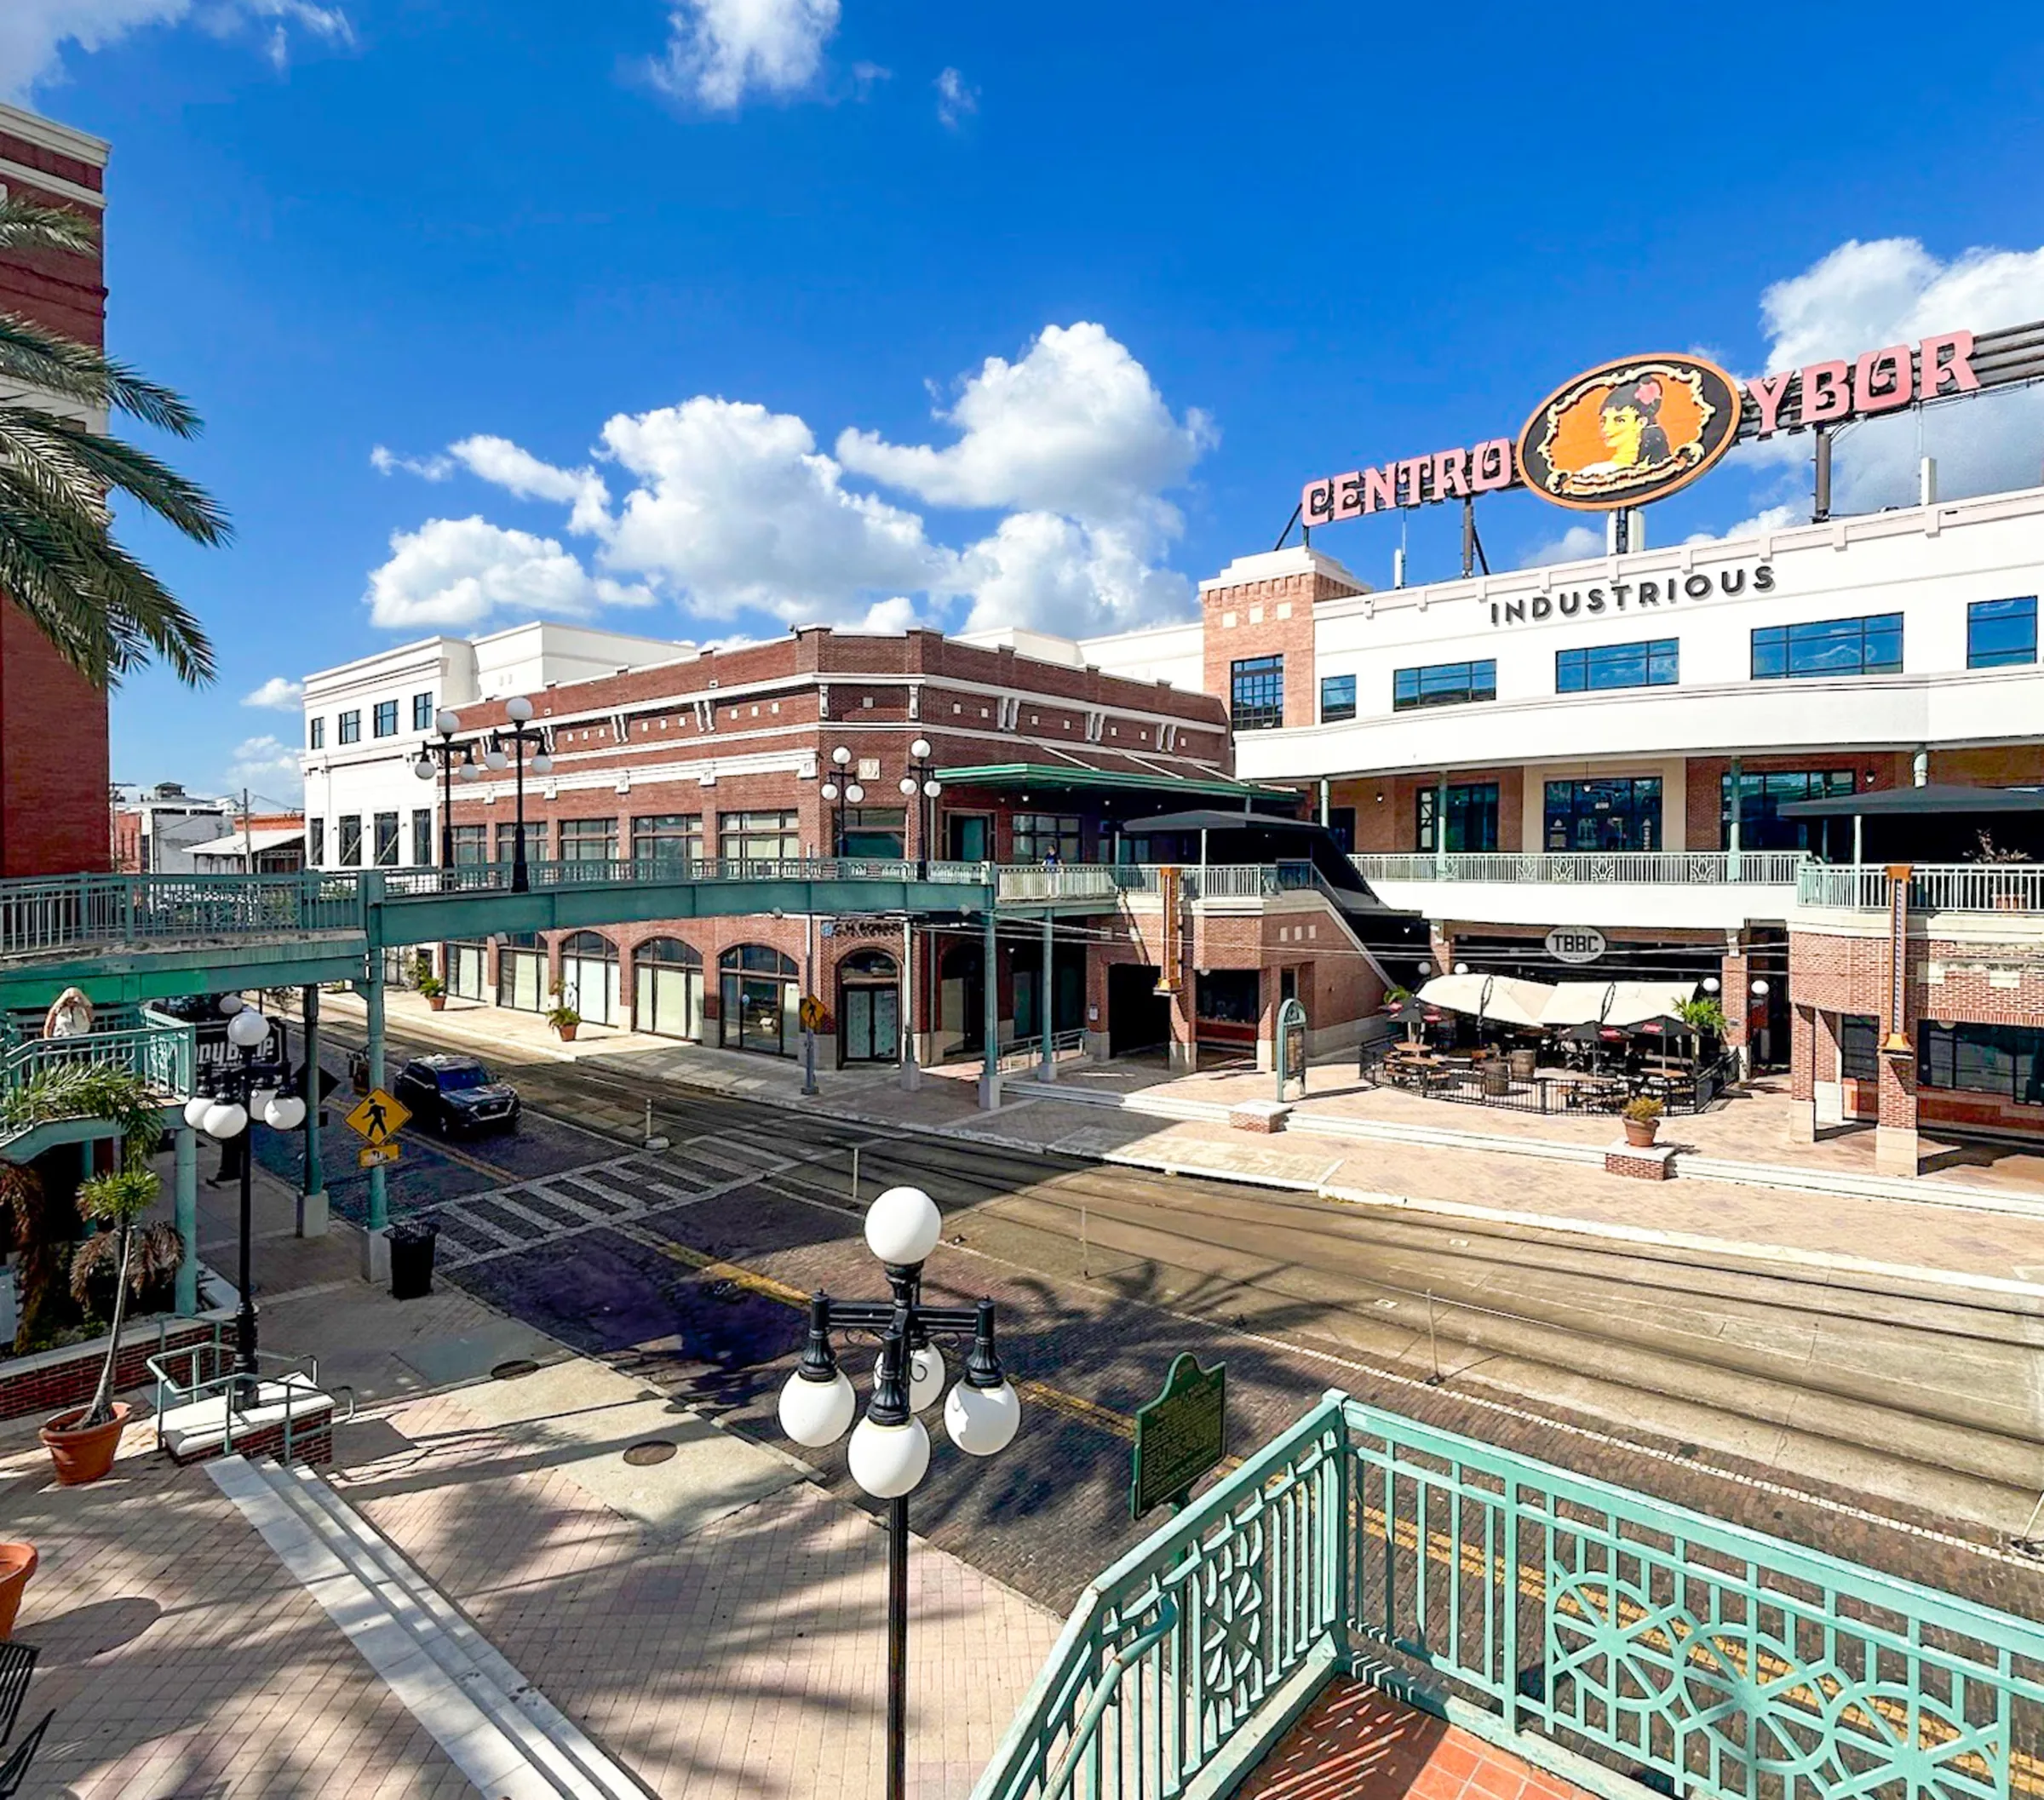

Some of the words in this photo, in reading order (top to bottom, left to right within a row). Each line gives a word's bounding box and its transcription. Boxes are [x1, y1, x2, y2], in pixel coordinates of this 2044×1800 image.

[1301, 437, 1513, 527] CENTRO
[1746, 329, 1981, 435] YBOR
[1490, 565, 1776, 626] INDUSTRIOUS
[1552, 934, 1599, 953] TBBC
